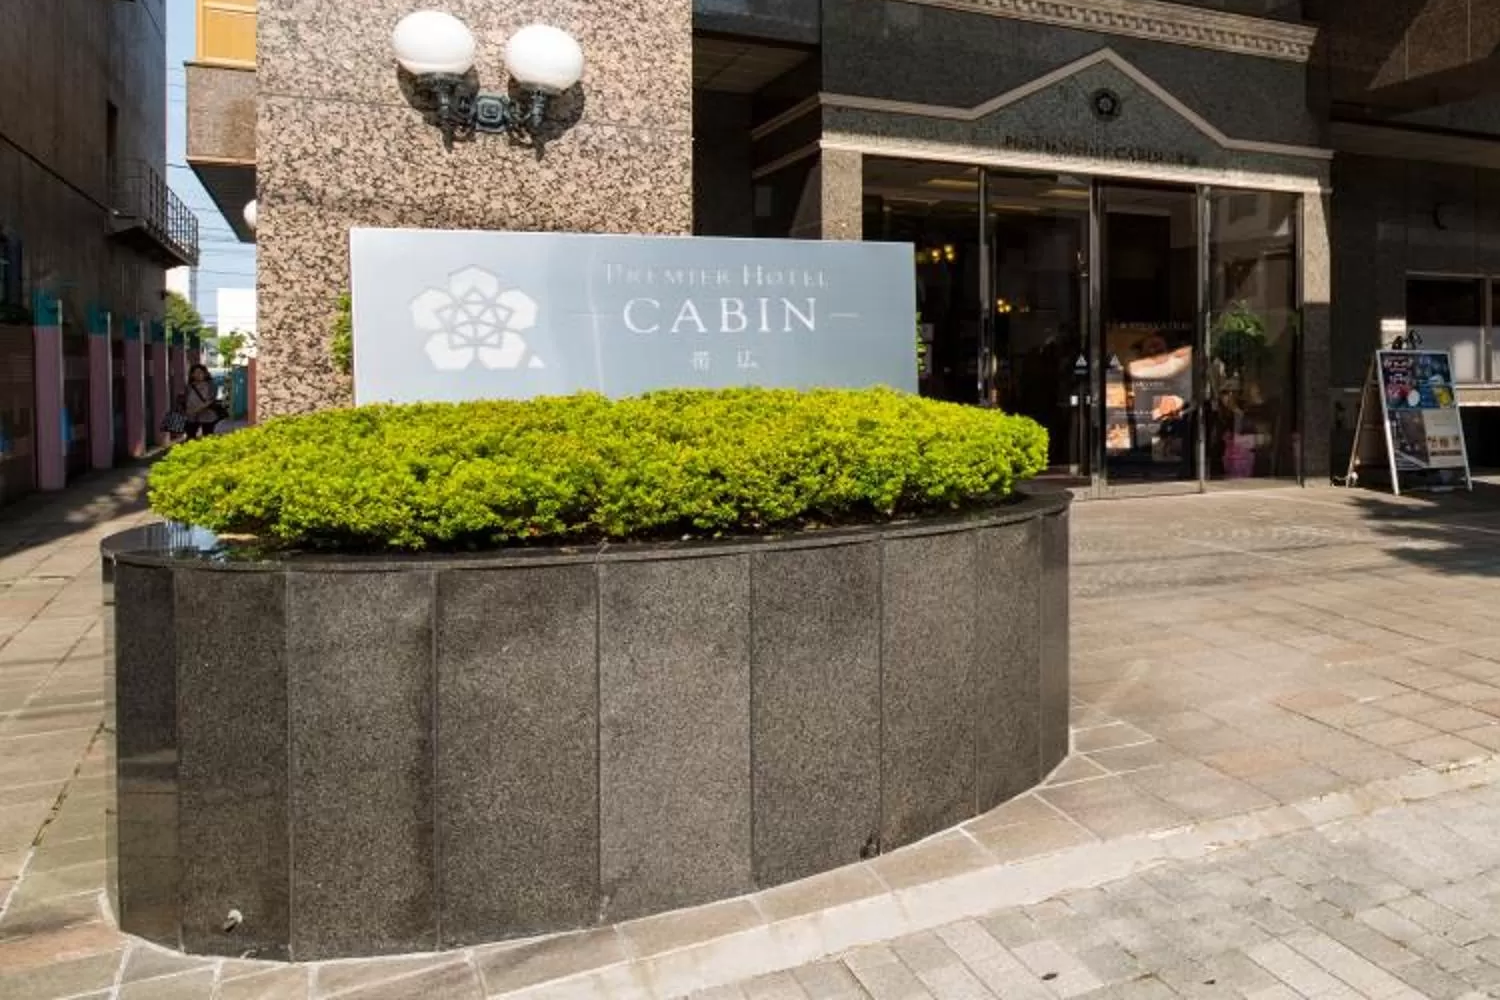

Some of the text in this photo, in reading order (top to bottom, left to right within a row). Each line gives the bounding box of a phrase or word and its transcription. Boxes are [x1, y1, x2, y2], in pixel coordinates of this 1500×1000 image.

[606, 263, 829, 289] PREMIER HOTEL
[623, 297, 817, 334] CABIN
